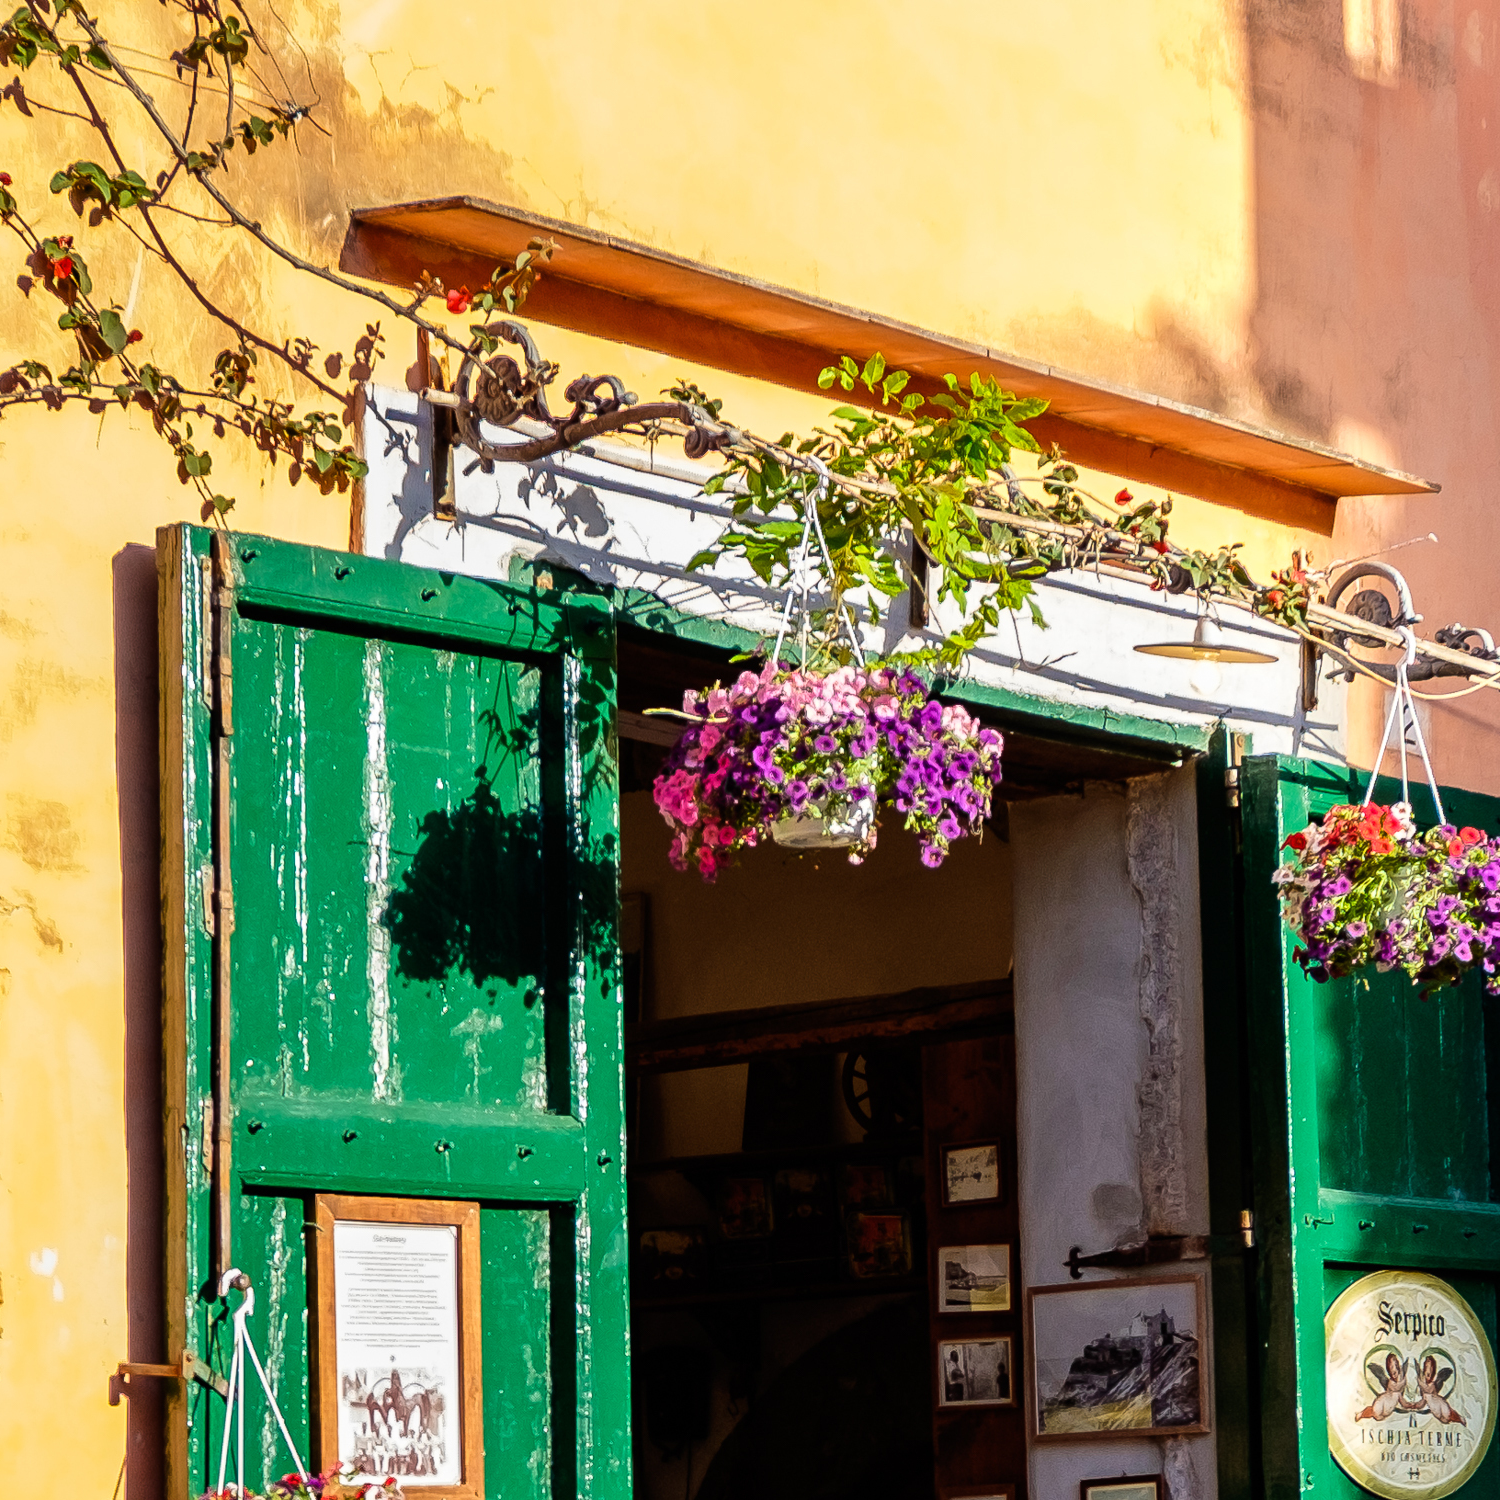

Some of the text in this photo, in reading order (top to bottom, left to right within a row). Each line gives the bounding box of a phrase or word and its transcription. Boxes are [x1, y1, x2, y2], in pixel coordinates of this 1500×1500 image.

[1373, 1300, 1445, 1343] Serpico
[1361, 1428, 1462, 1448] ISCHIA TERME
